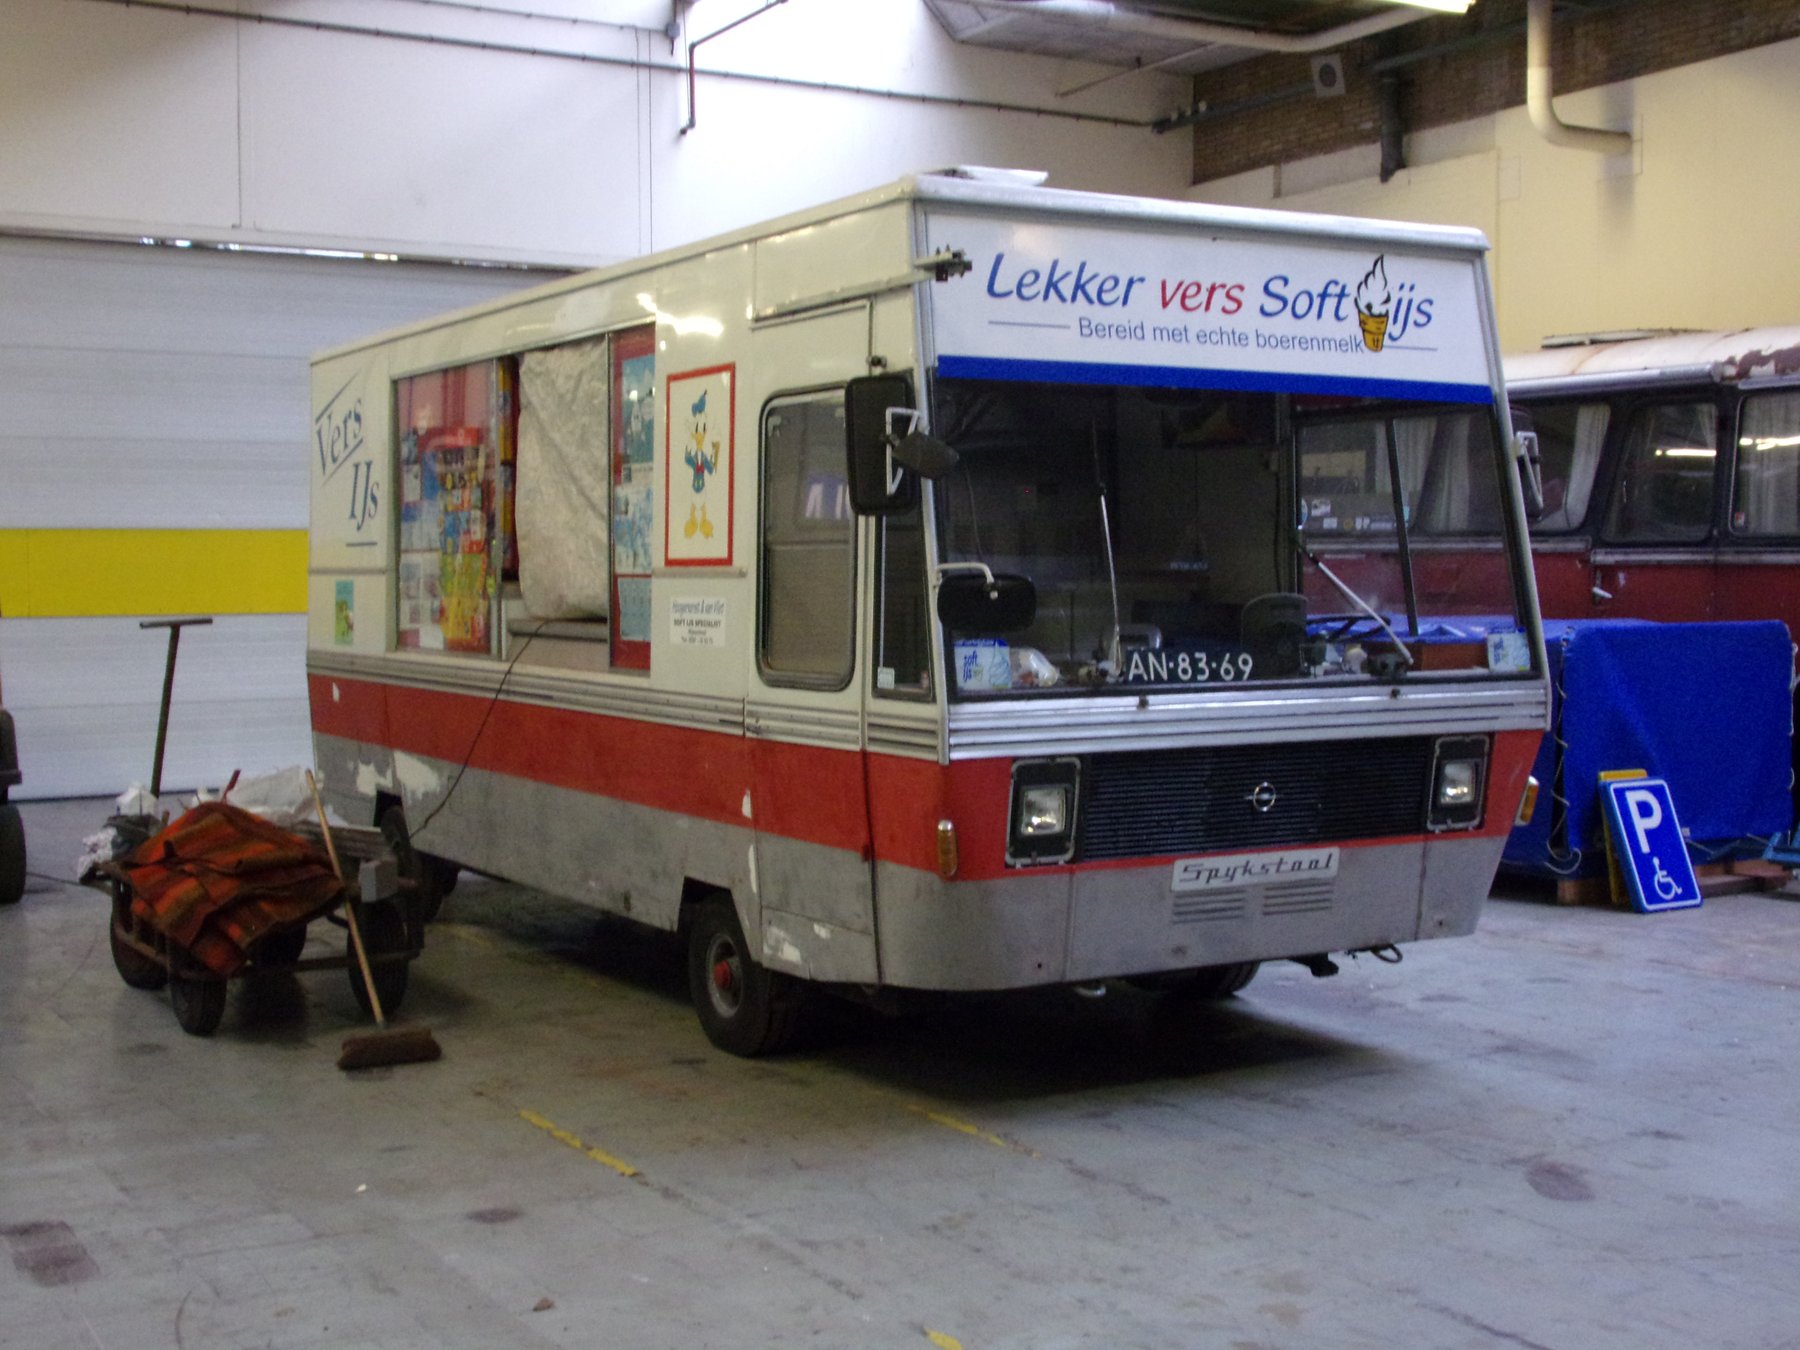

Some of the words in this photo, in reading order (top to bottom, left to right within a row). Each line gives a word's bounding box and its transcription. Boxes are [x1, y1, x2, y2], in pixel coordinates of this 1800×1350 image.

[986, 252, 1146, 307] Lekker
[1160, 278, 1245, 315] vers
[1259, 274, 1350, 322] Soft
[1388, 282, 1434, 342] ijs
[1078, 316, 1145, 341] Bereid
[1153, 324, 1189, 344] met
[1196, 326, 1249, 347] echte
[1255, 328, 1365, 354] boerenmelk
[316, 397, 363, 476] Vers
[1625, 789, 1663, 854] P
